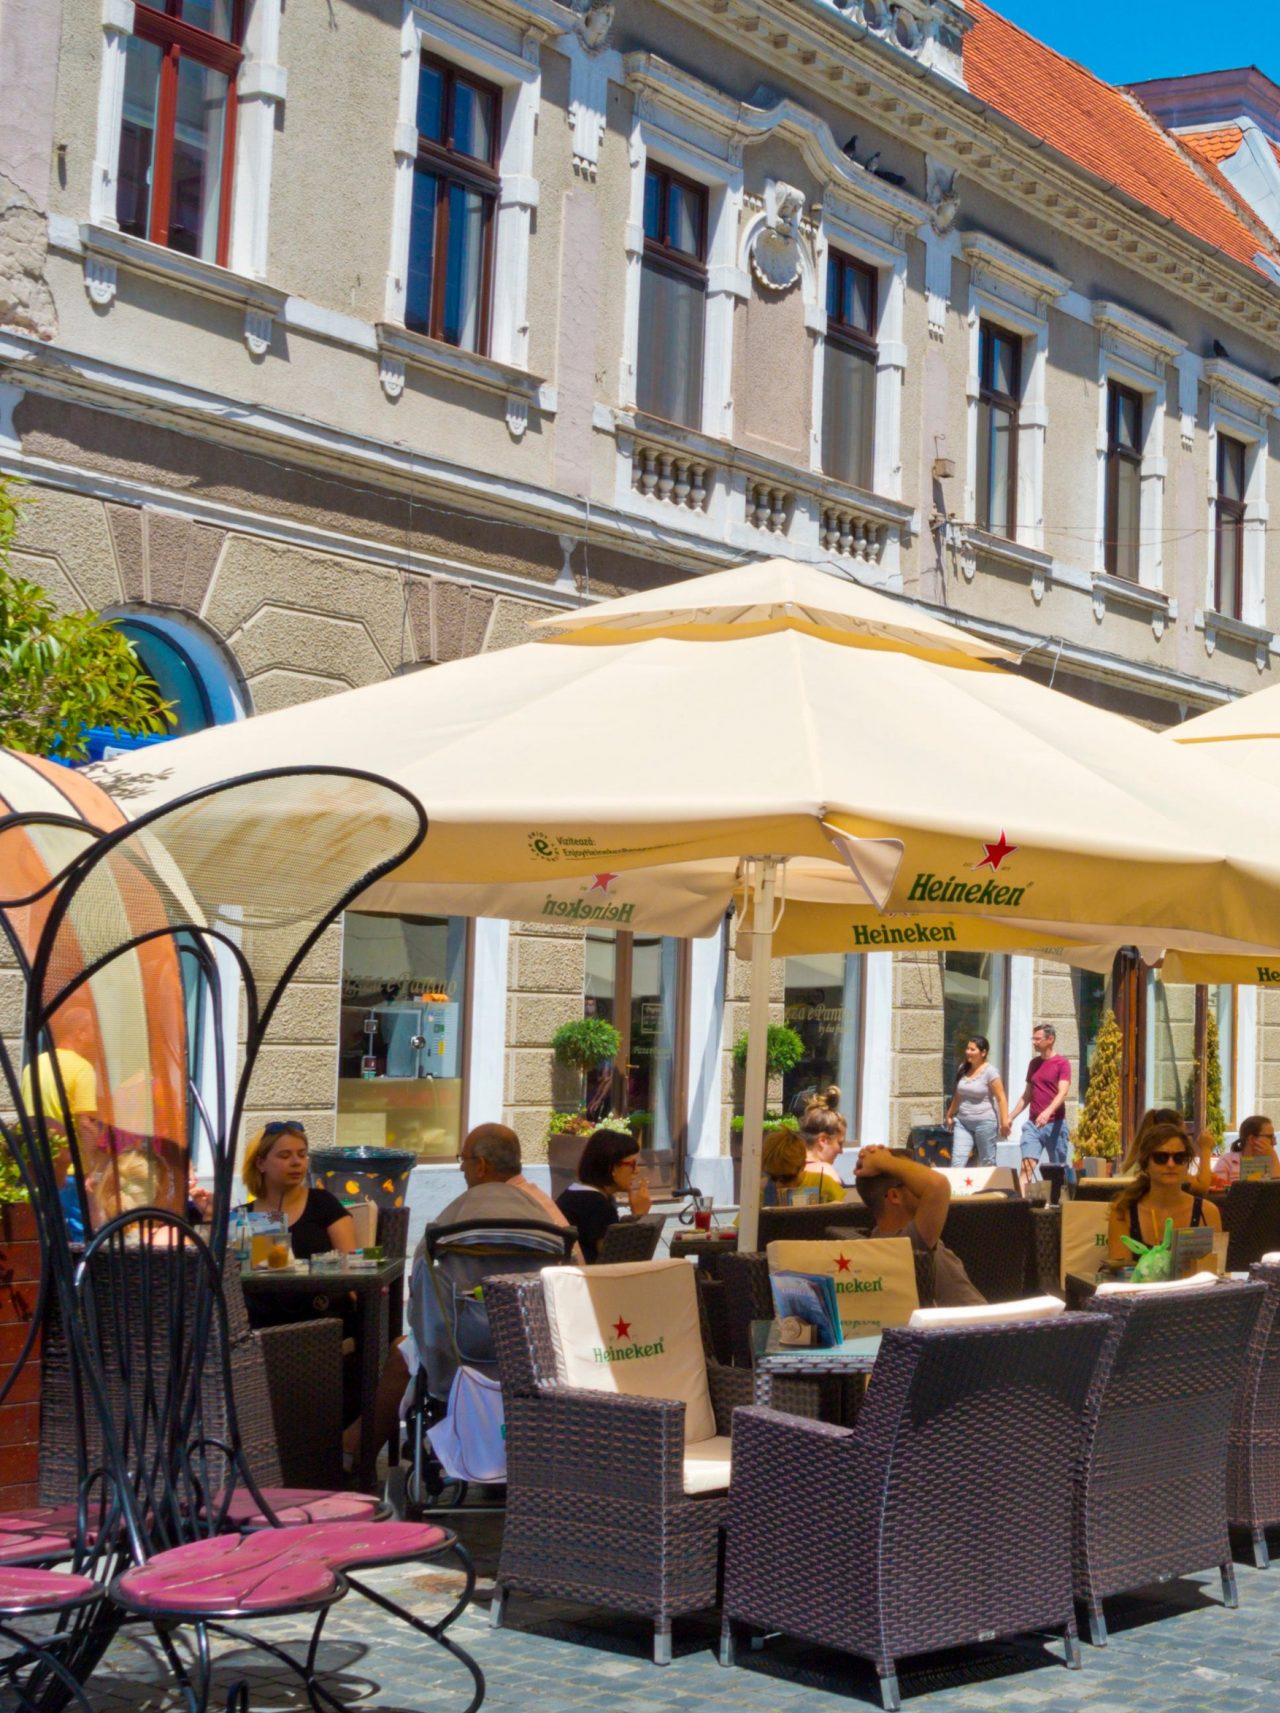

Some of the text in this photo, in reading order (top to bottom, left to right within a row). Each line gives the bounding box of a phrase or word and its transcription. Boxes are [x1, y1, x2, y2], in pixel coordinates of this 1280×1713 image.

[907, 873, 1026, 907] Heineken
[852, 923, 957, 945] Heineken
[835, 1279, 883, 1294] neken
[592, 1342, 664, 1364] Heineken
